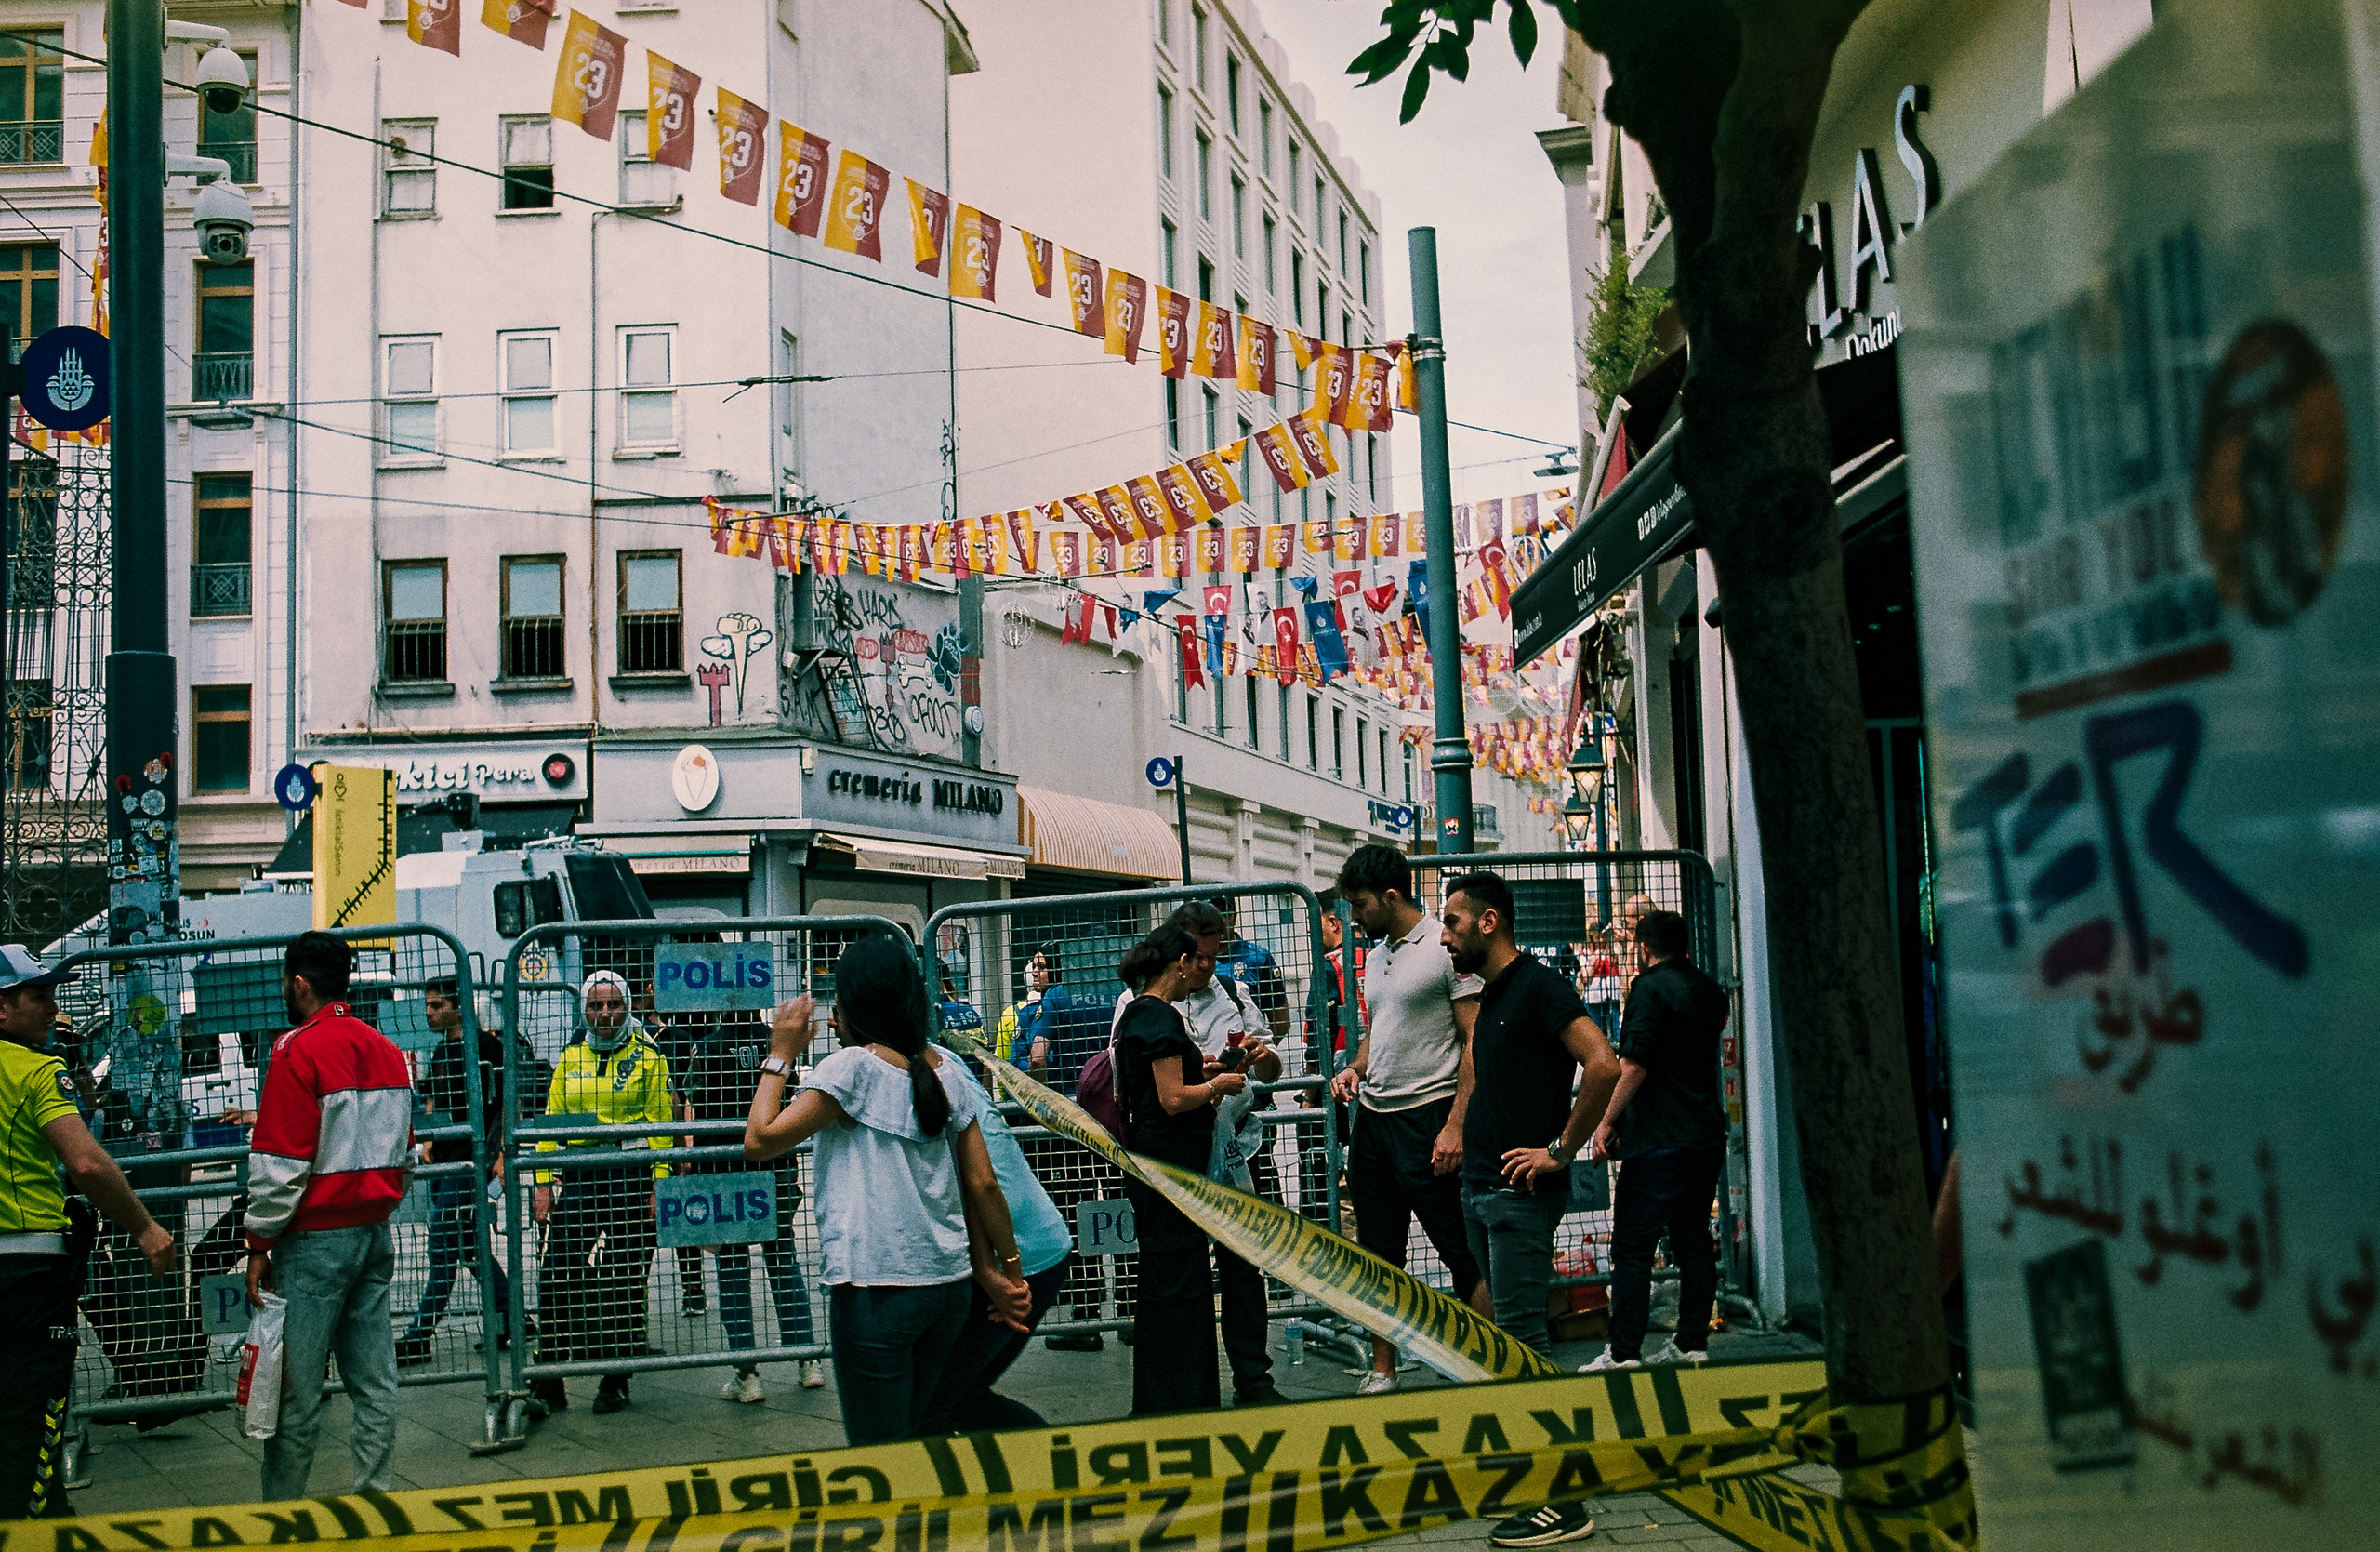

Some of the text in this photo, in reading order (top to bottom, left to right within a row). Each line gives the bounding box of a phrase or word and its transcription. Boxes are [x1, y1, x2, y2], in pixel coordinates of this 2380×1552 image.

[575, 51, 607, 99] 23
[720, 126, 753, 167] 23
[784, 159, 813, 199] 23
[845, 186, 875, 225] 23
[1796, 84, 1929, 346] LAS
[966, 236, 991, 271] 23
[1071, 272, 1092, 305] 23
[1206, 321, 1223, 352] 23
[1250, 337, 1265, 367] 23
[1359, 378, 1382, 406] 23
[1272, 537, 1289, 553] 23
[1377, 526, 1394, 542] 23
[1056, 546, 1073, 563] 23
[1130, 546, 1147, 562] 23
[1169, 546, 1183, 562] 23
[1203, 541, 1219, 558] 23
[1238, 541, 1254, 557] 23
[1573, 546, 1597, 596] LELAS
[476, 764, 535, 785] Pera
[829, 769, 1003, 815] cremeria MILANO
[633, 857, 740, 871] meria MILANO
[917, 856, 960, 876] MILANO
[178, 929, 215, 941] OSUN
[49, 1326, 78, 1339] TRA
[1320, 1447, 1603, 1538] KAZA
